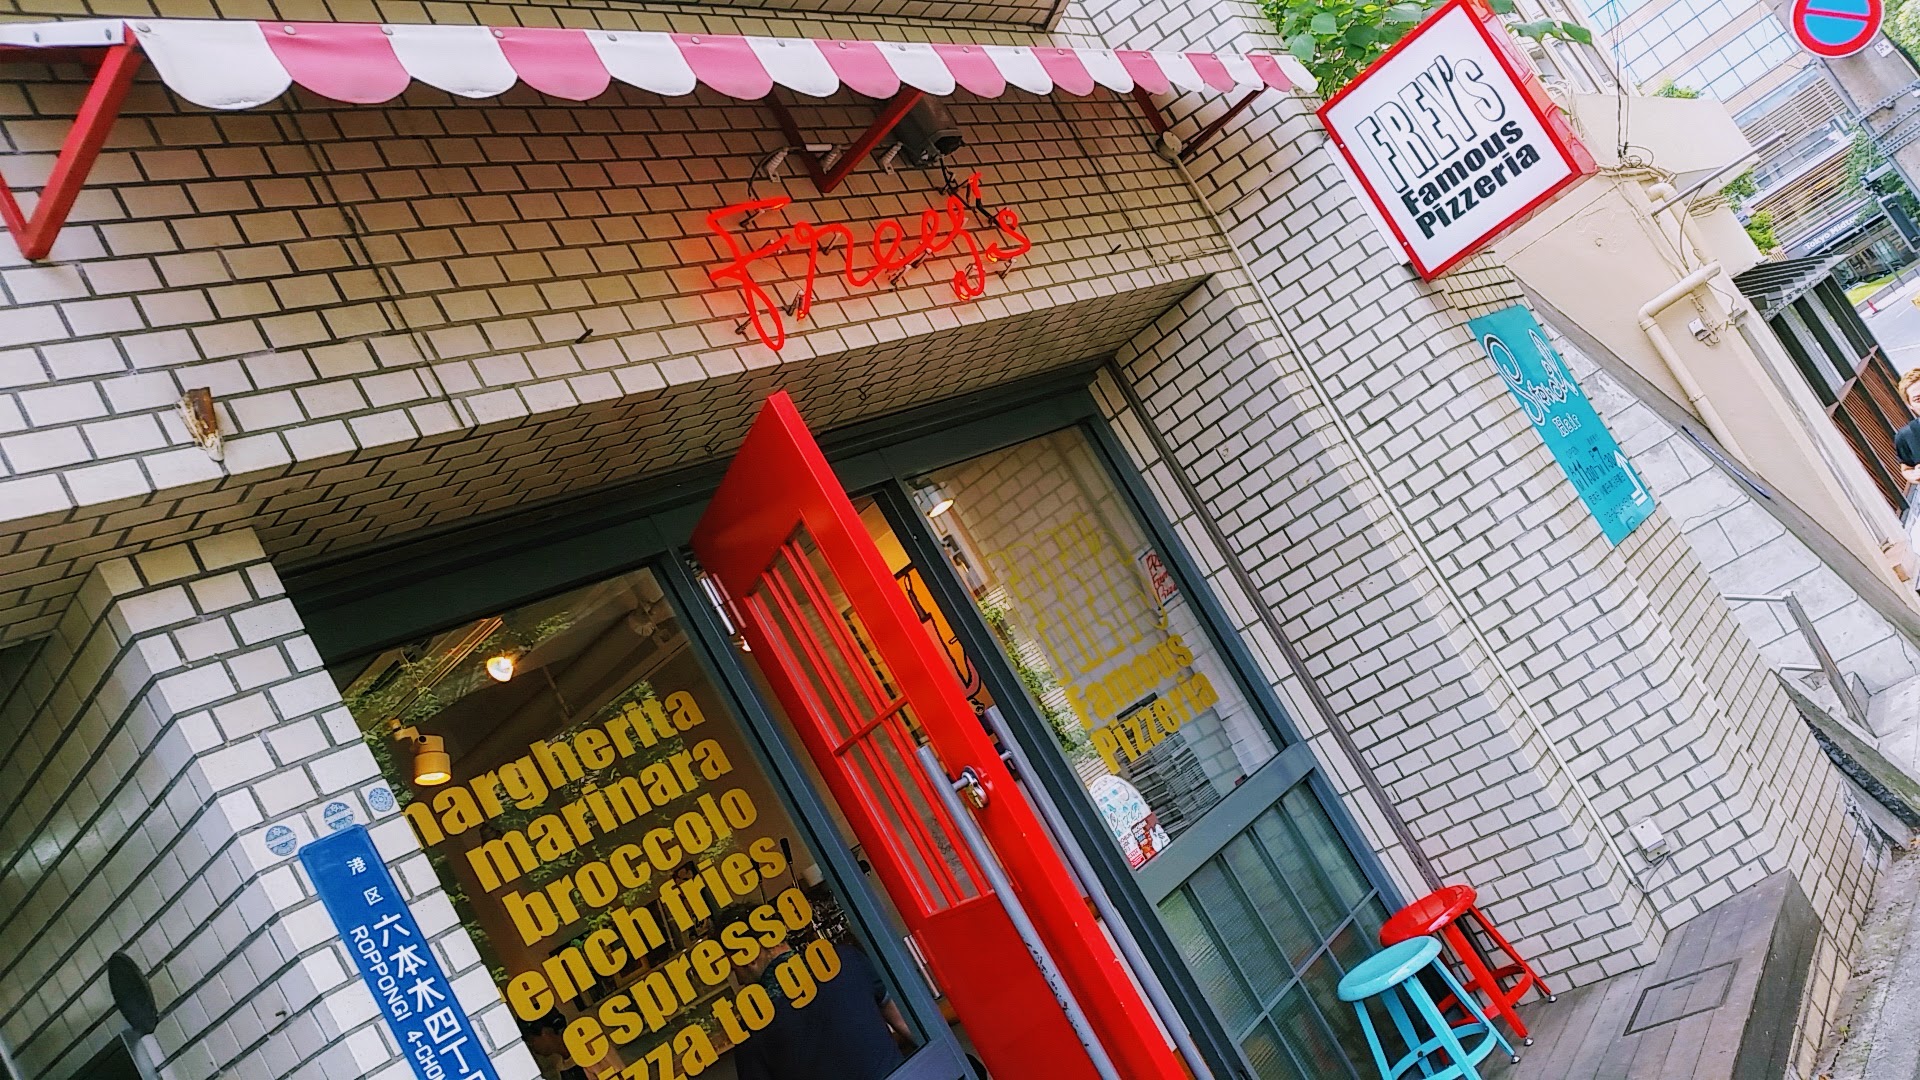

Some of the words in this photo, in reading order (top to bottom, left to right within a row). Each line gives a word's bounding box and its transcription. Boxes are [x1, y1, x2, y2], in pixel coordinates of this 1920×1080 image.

[1355, 55, 1506, 193] FREY'S
[1401, 120, 1524, 217] Famous
[1415, 143, 1541, 240] Pizzeria
[1804, 230, 1831, 250] Tokyo
[1552, 412, 1582, 438] Hair
[1064, 634, 1194, 731] Famous
[1090, 671, 1220, 775] Pizzeria
[465, 738, 735, 893] marinara
[502, 787, 759, 947] broccolo
[350, 925, 413, 1022] ROPPONGI
[498, 904, 666, 1022] ench
[658, 836, 788, 933] fries
[562, 886, 814, 1069] espresso
[373, 912, 487, 1080] 六本木四丁
[711, 983, 776, 1045] to
[774, 938, 841, 1009] go
